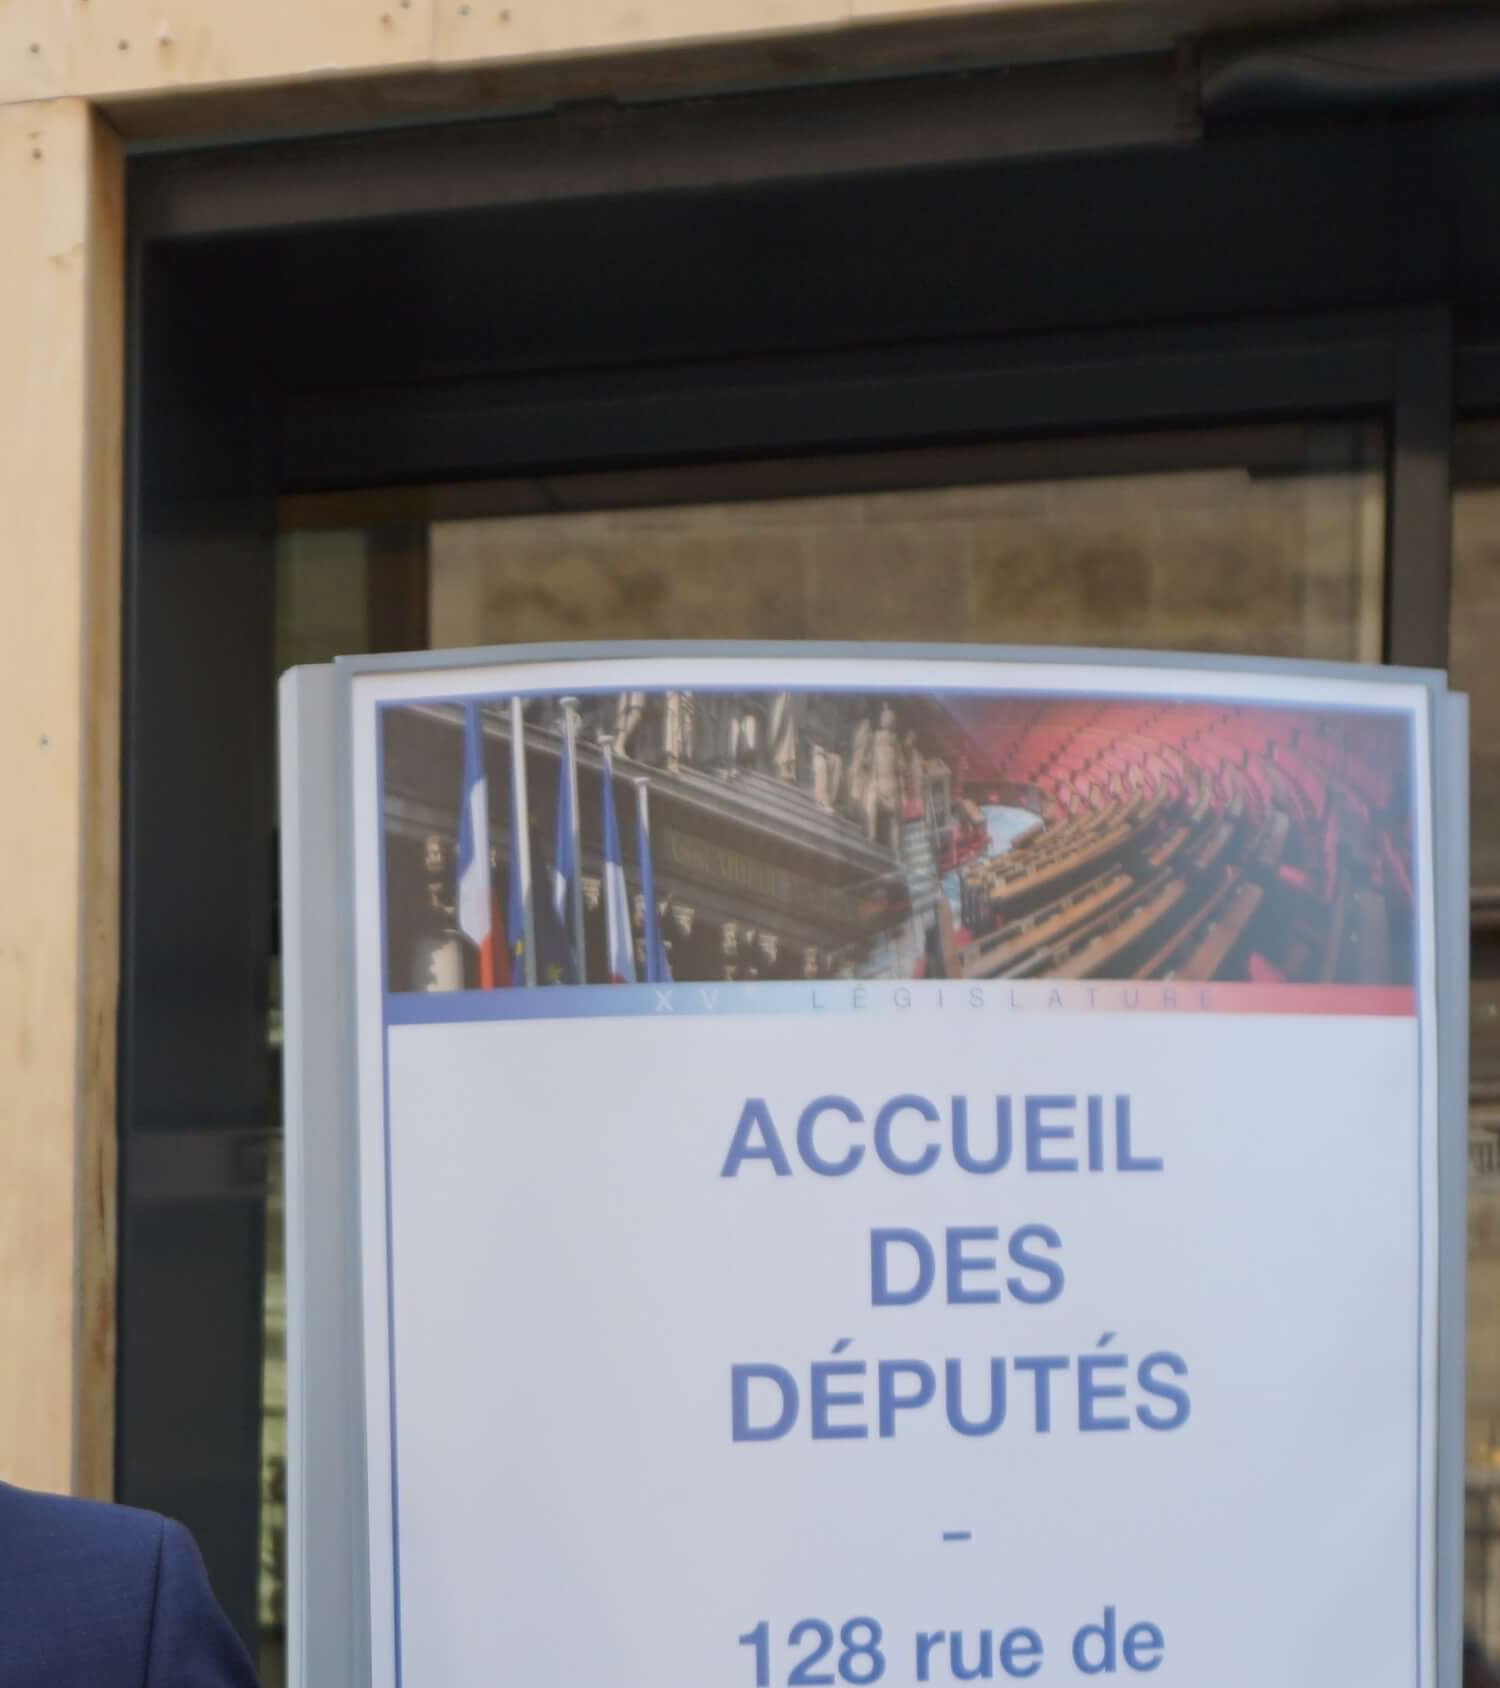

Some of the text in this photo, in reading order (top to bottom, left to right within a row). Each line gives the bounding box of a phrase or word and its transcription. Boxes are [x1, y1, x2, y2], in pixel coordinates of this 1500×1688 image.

[720, 1093, 1164, 1178] ACCUEIL
[869, 1223, 1066, 1308] DES
[730, 1331, 1192, 1443] DÉPUTÉS
[738, 1605, 1166, 1688] 128 rue de
